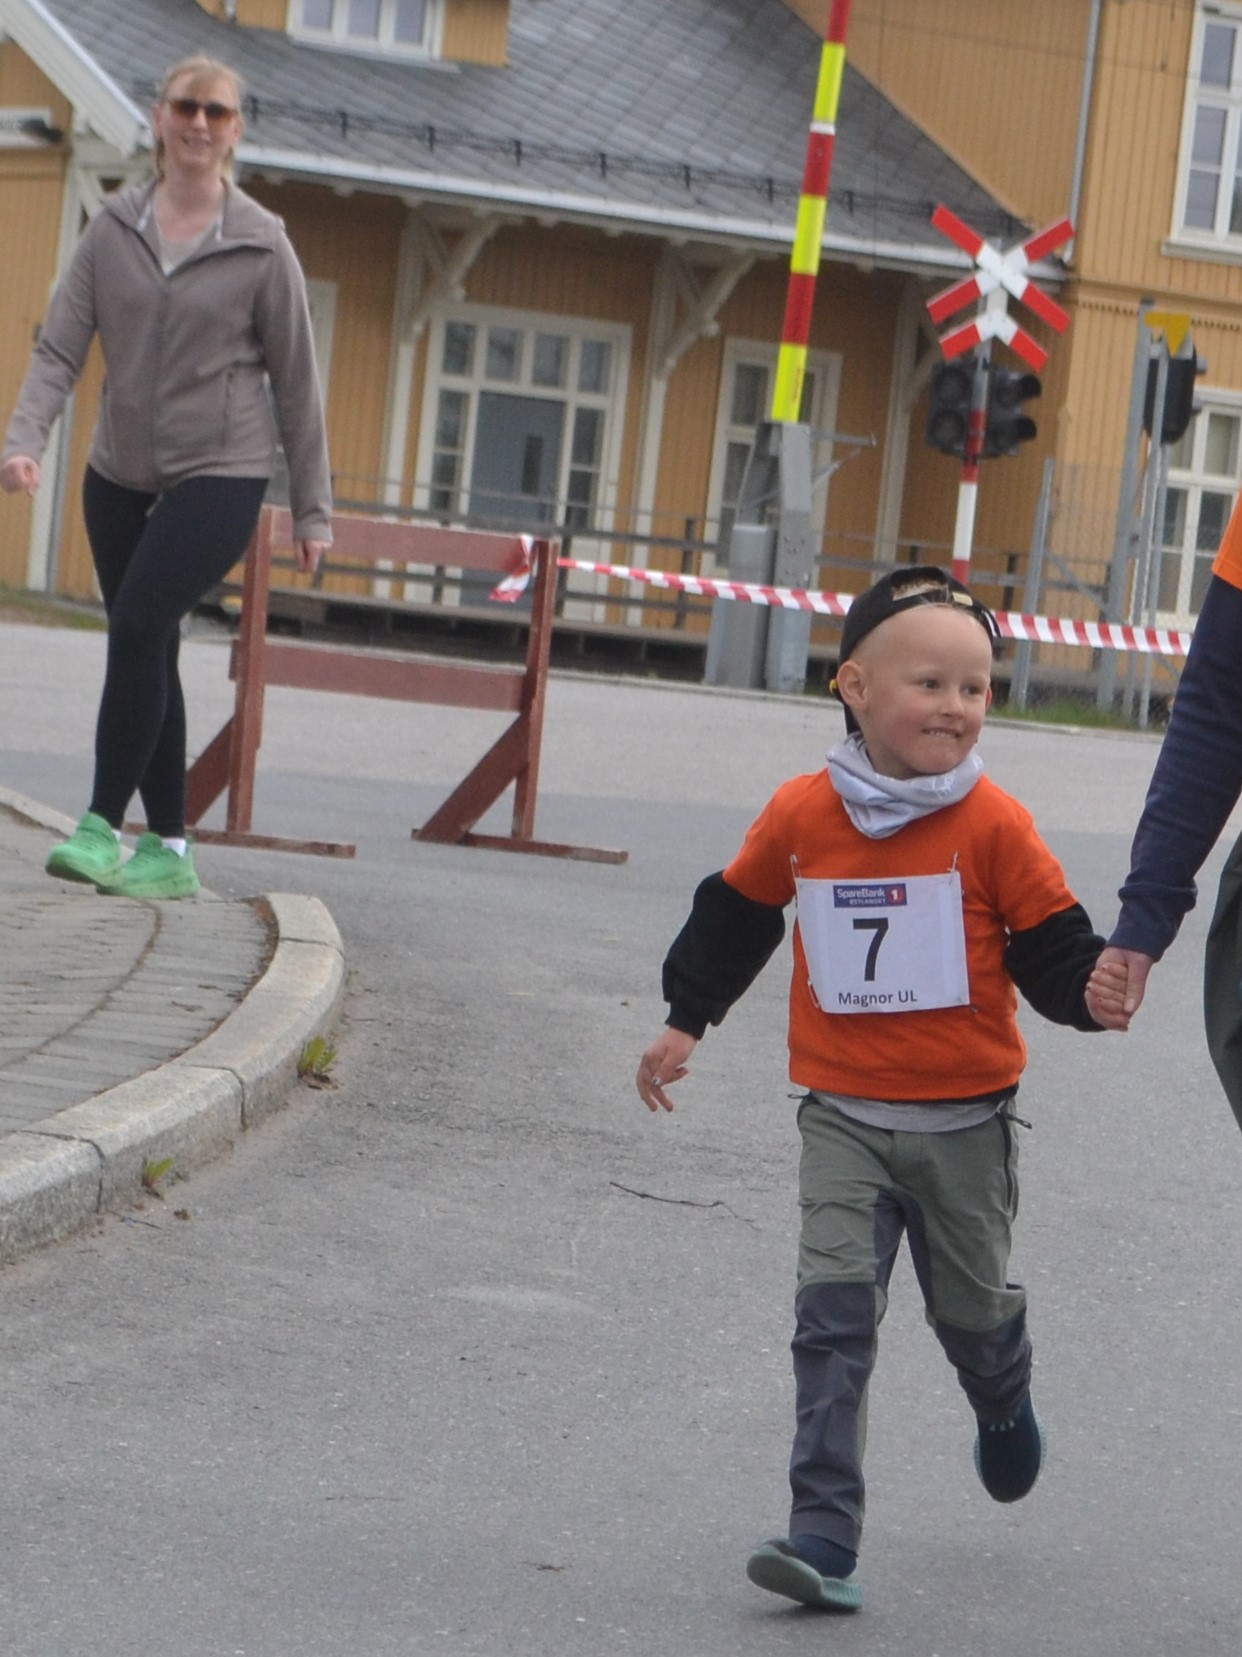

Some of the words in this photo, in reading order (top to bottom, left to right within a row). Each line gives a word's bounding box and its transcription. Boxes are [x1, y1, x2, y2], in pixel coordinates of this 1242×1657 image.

[837, 888, 886, 900] SpareBank
[891, 889, 898, 901] 1
[852, 917, 890, 982] 7
[838, 992, 894, 1008] Magnor
[898, 989, 918, 1003] UL
